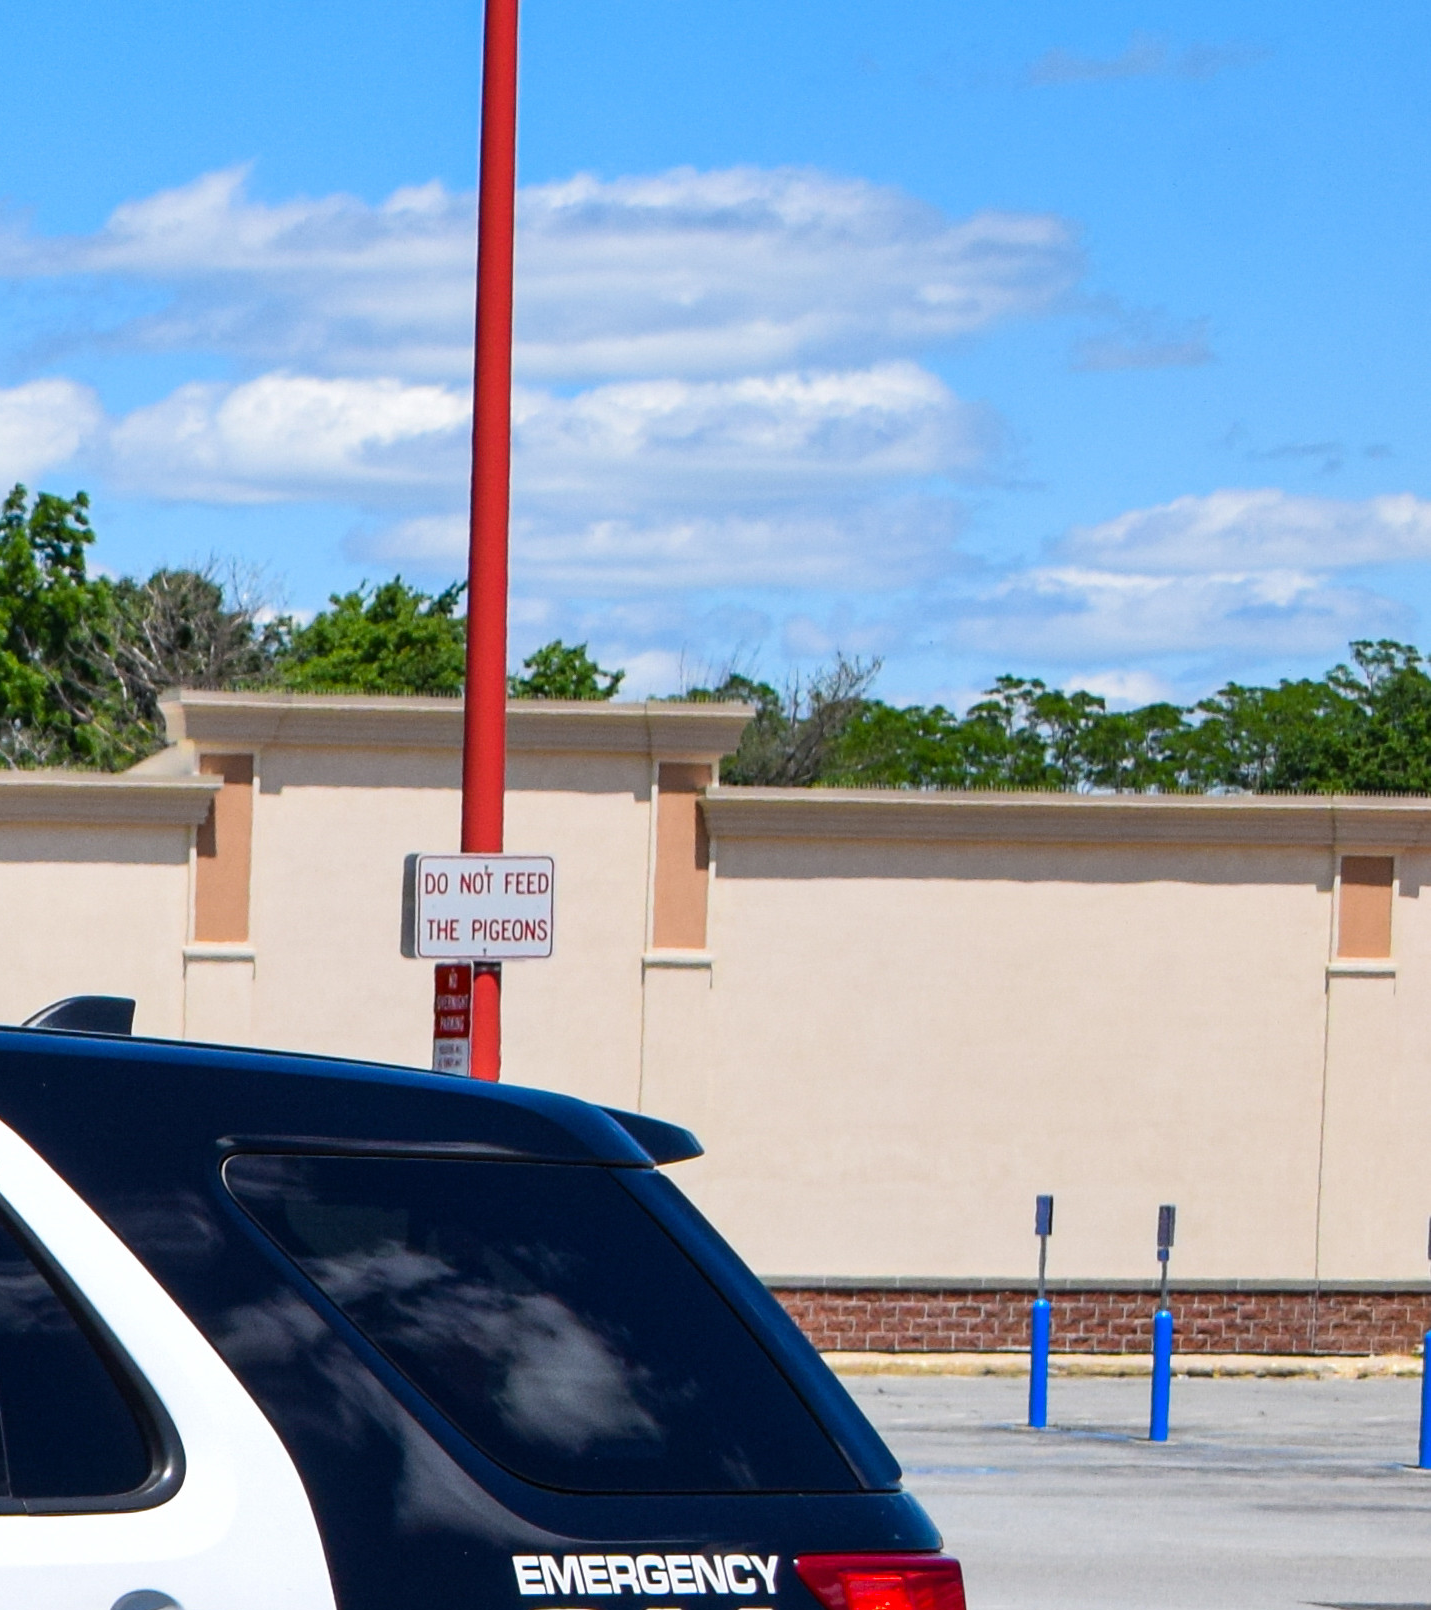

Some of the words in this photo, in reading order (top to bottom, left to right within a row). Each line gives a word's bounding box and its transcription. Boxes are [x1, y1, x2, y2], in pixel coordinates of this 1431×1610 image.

[425, 873, 448, 894] DO
[460, 873, 494, 894] NOT
[505, 873, 549, 894] FEED
[427, 919, 459, 941] THE
[471, 919, 548, 941] PIGEONS
[511, 1554, 779, 1596] EMERGENCY
